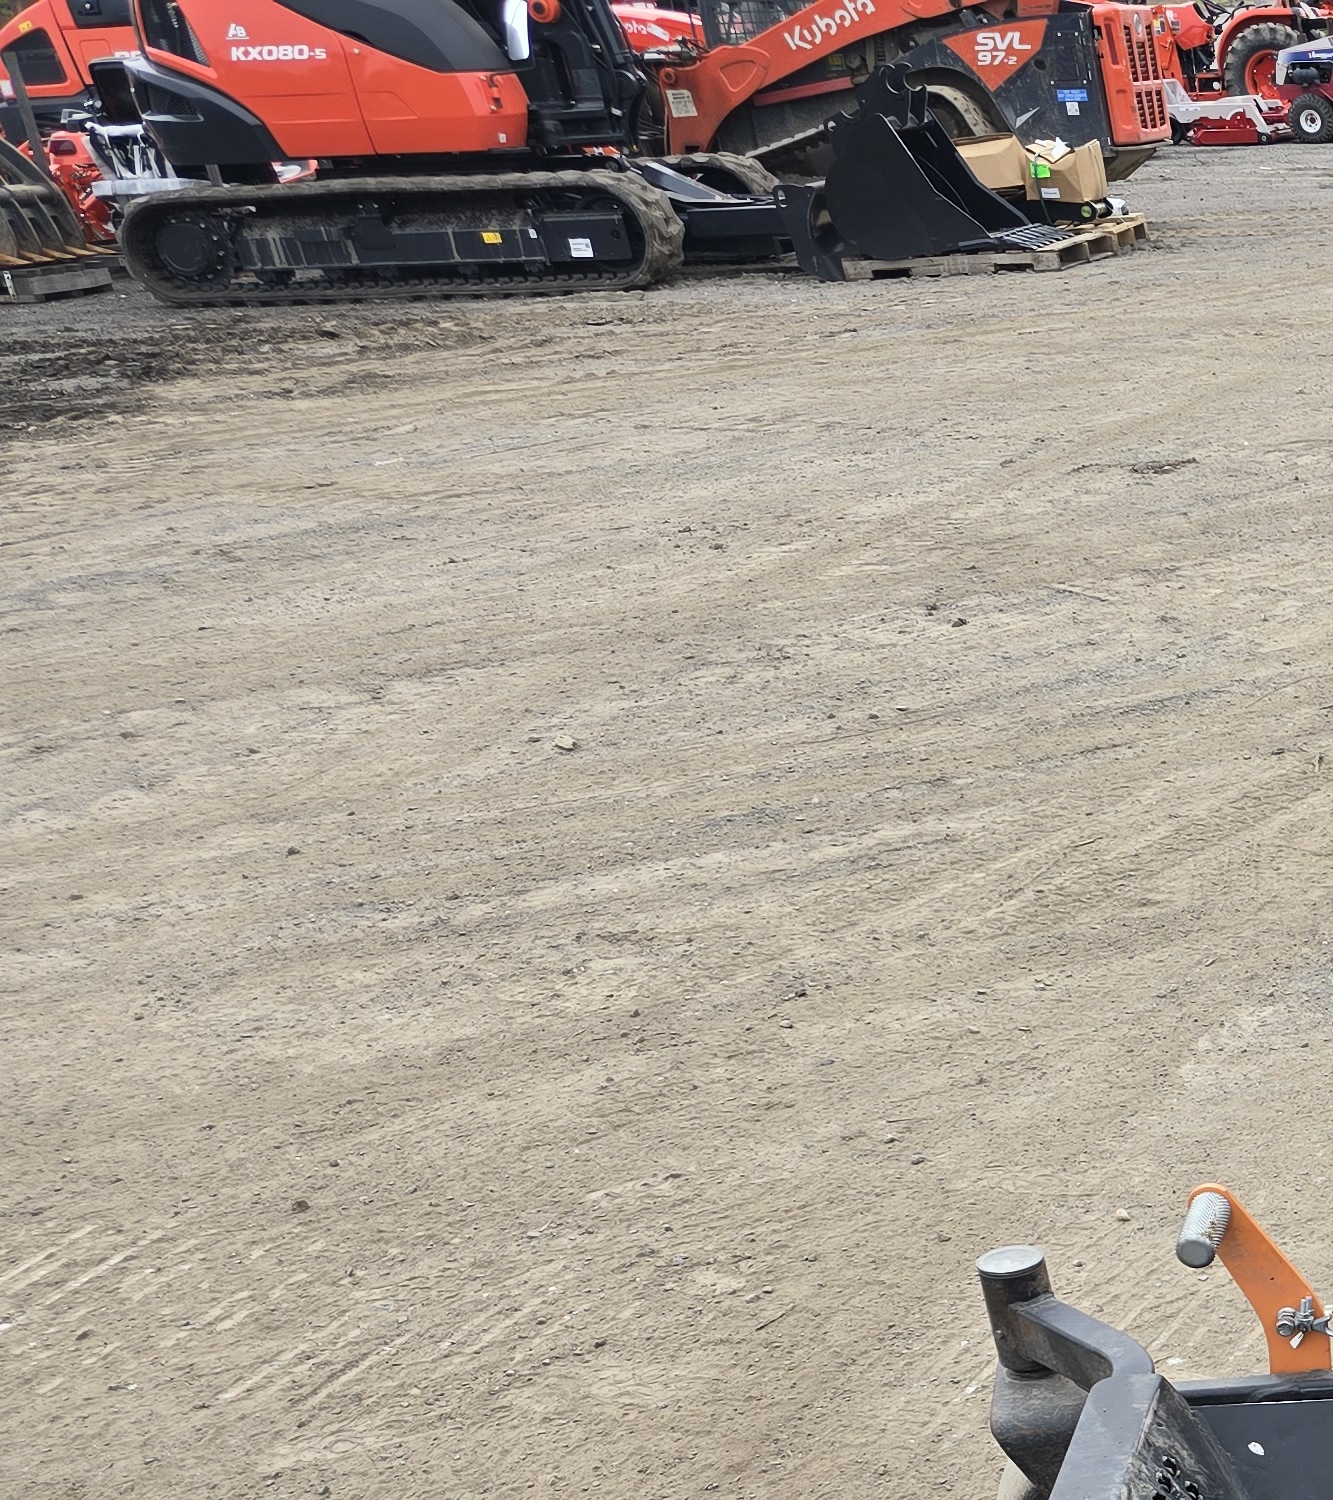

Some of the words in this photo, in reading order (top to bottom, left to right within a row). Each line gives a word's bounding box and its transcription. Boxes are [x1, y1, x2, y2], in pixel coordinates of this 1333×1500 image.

[783, 0, 876, 51] Kubota
[975, 31, 1032, 50] SVL
[231, 45, 327, 61] KX080-5
[977, 51, 1018, 66] 97-2
